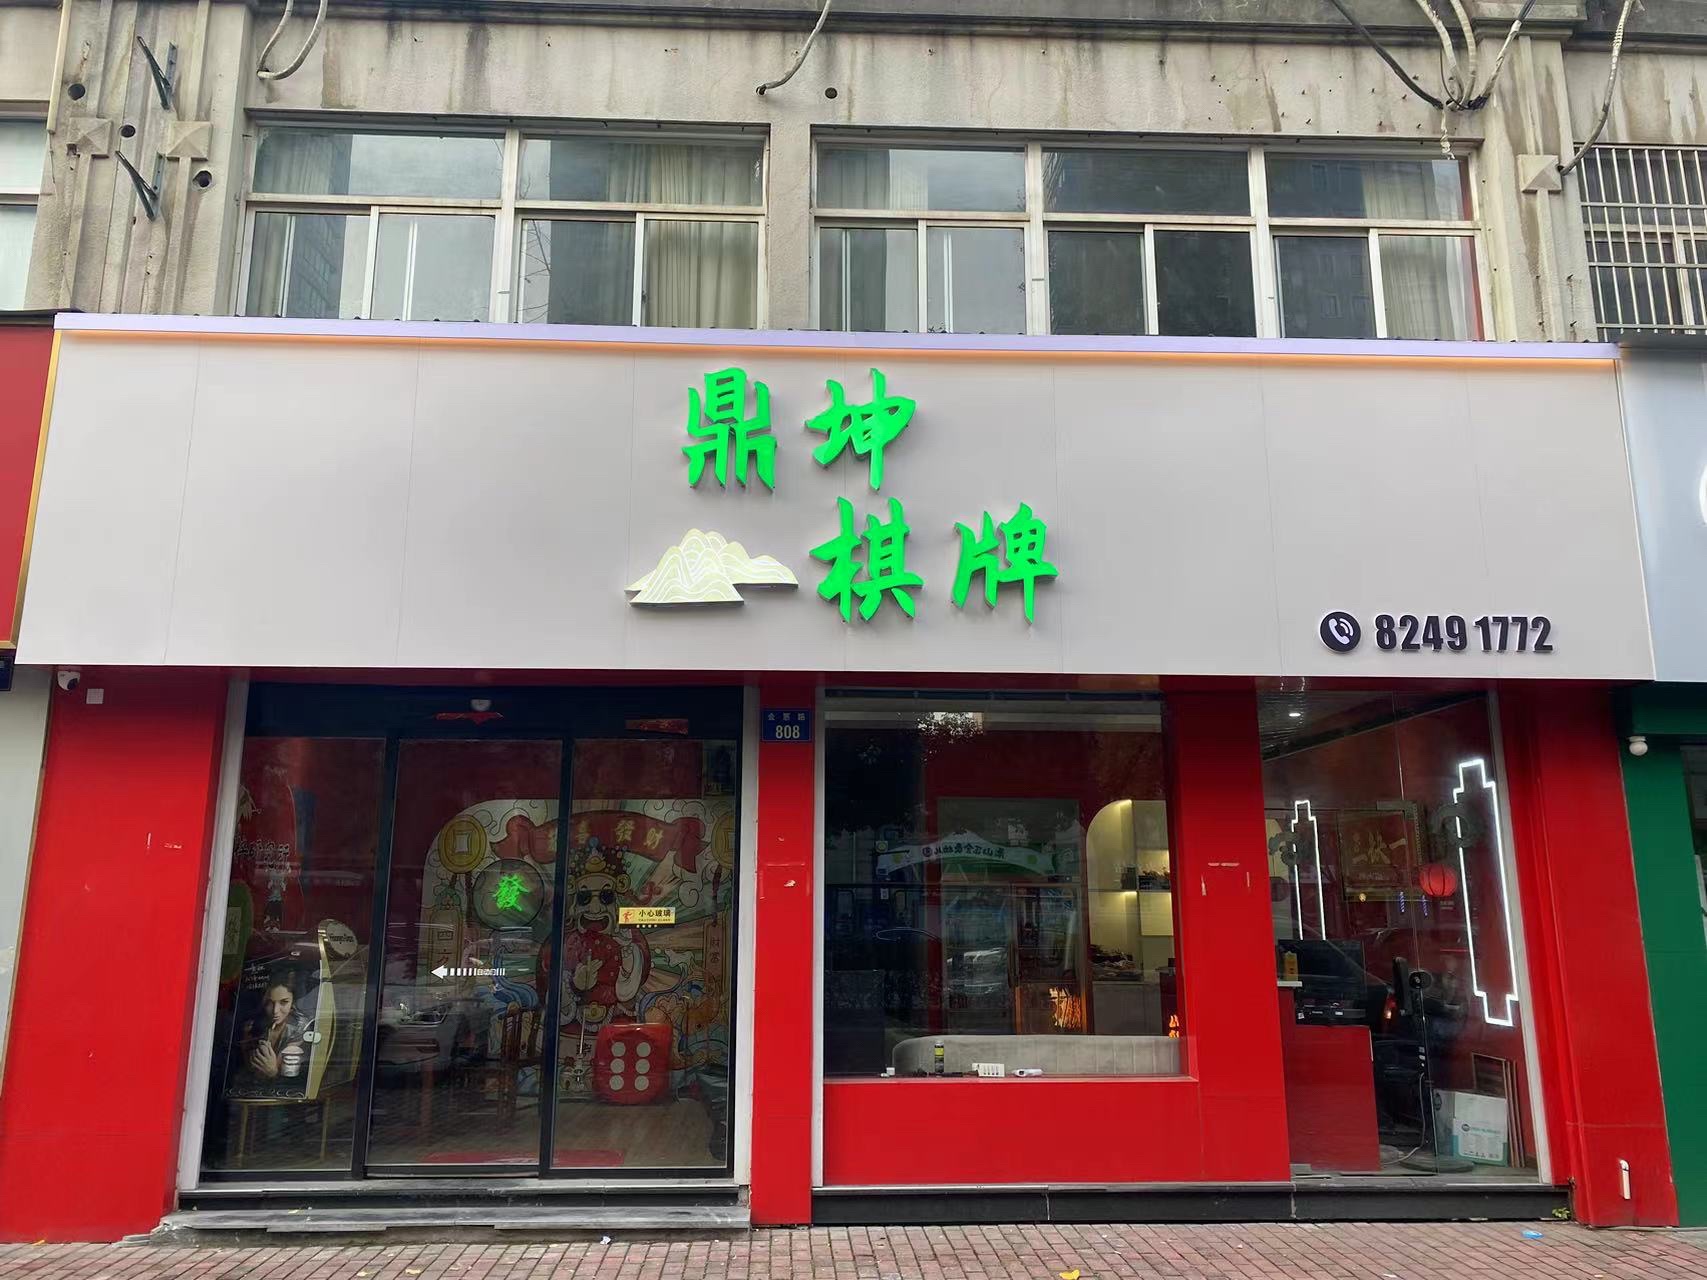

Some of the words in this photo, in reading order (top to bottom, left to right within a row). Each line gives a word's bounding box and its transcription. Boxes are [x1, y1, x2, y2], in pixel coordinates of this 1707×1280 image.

[681, 367, 917, 490] 鼎坤
[810, 497, 1059, 622] 棋牌
[775, 725, 800, 739] 808
[638, 909, 671, 918] 小心玻璃
